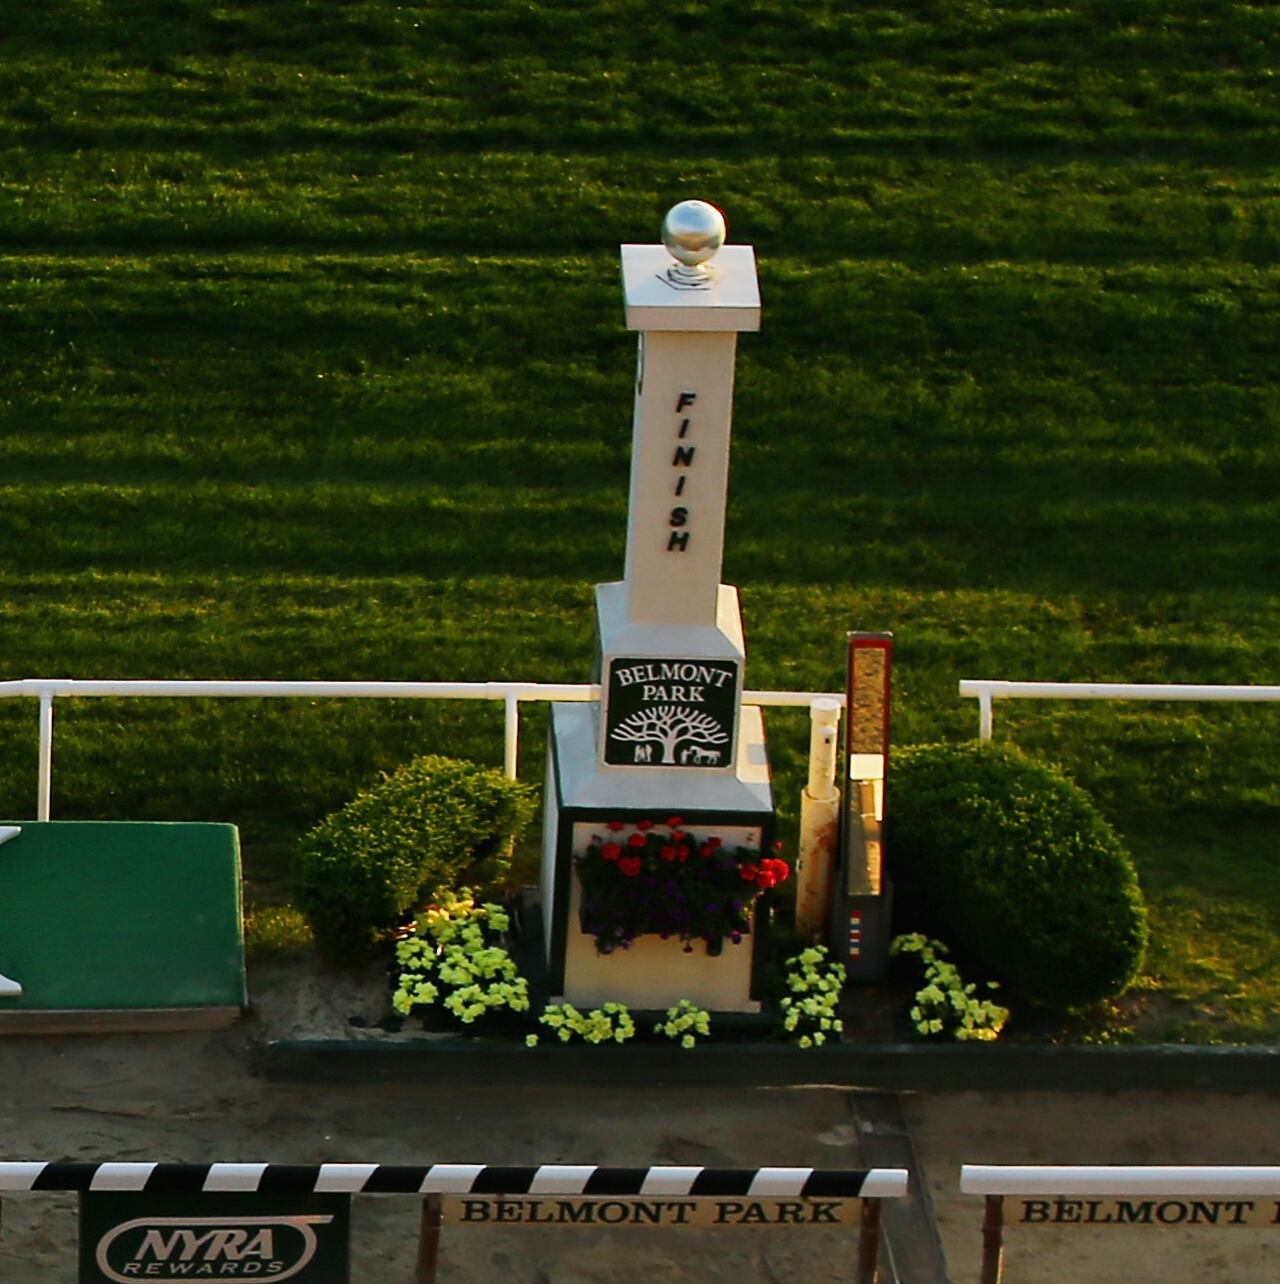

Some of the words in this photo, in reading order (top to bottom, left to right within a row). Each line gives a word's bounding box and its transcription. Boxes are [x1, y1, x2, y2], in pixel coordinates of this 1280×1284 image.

[666, 391, 697, 552] FINISH
[615, 663, 733, 688] BELMONT
[641, 685, 705, 702] PARK
[459, 1200, 696, 1224] BELMONT
[713, 1201, 844, 1225] PARK
[1019, 1200, 1255, 1225] BELMONT
[134, 1228, 274, 1262] NYRA
[122, 1261, 285, 1275] REWARDS
